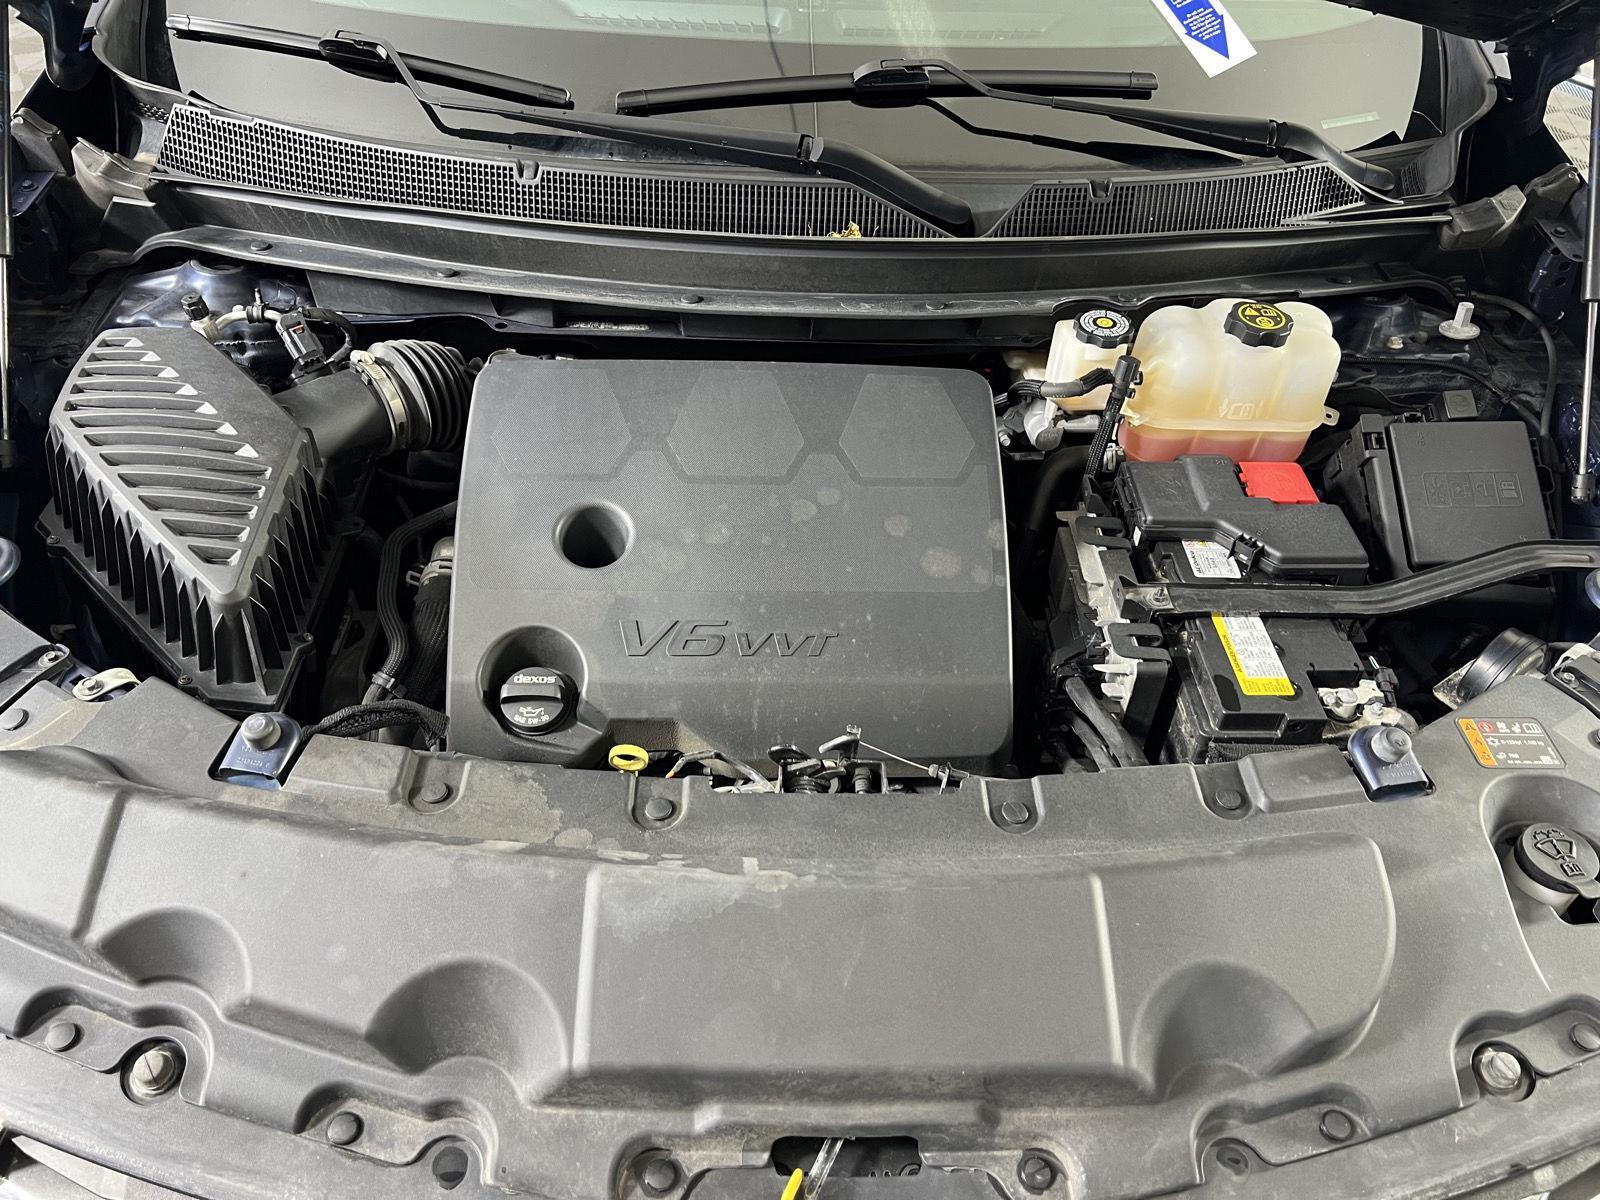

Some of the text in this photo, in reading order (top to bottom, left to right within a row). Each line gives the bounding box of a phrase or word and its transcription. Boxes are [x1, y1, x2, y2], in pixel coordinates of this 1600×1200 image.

[618, 619, 840, 657] V6 VVT
[513, 673, 558, 684] dexos
